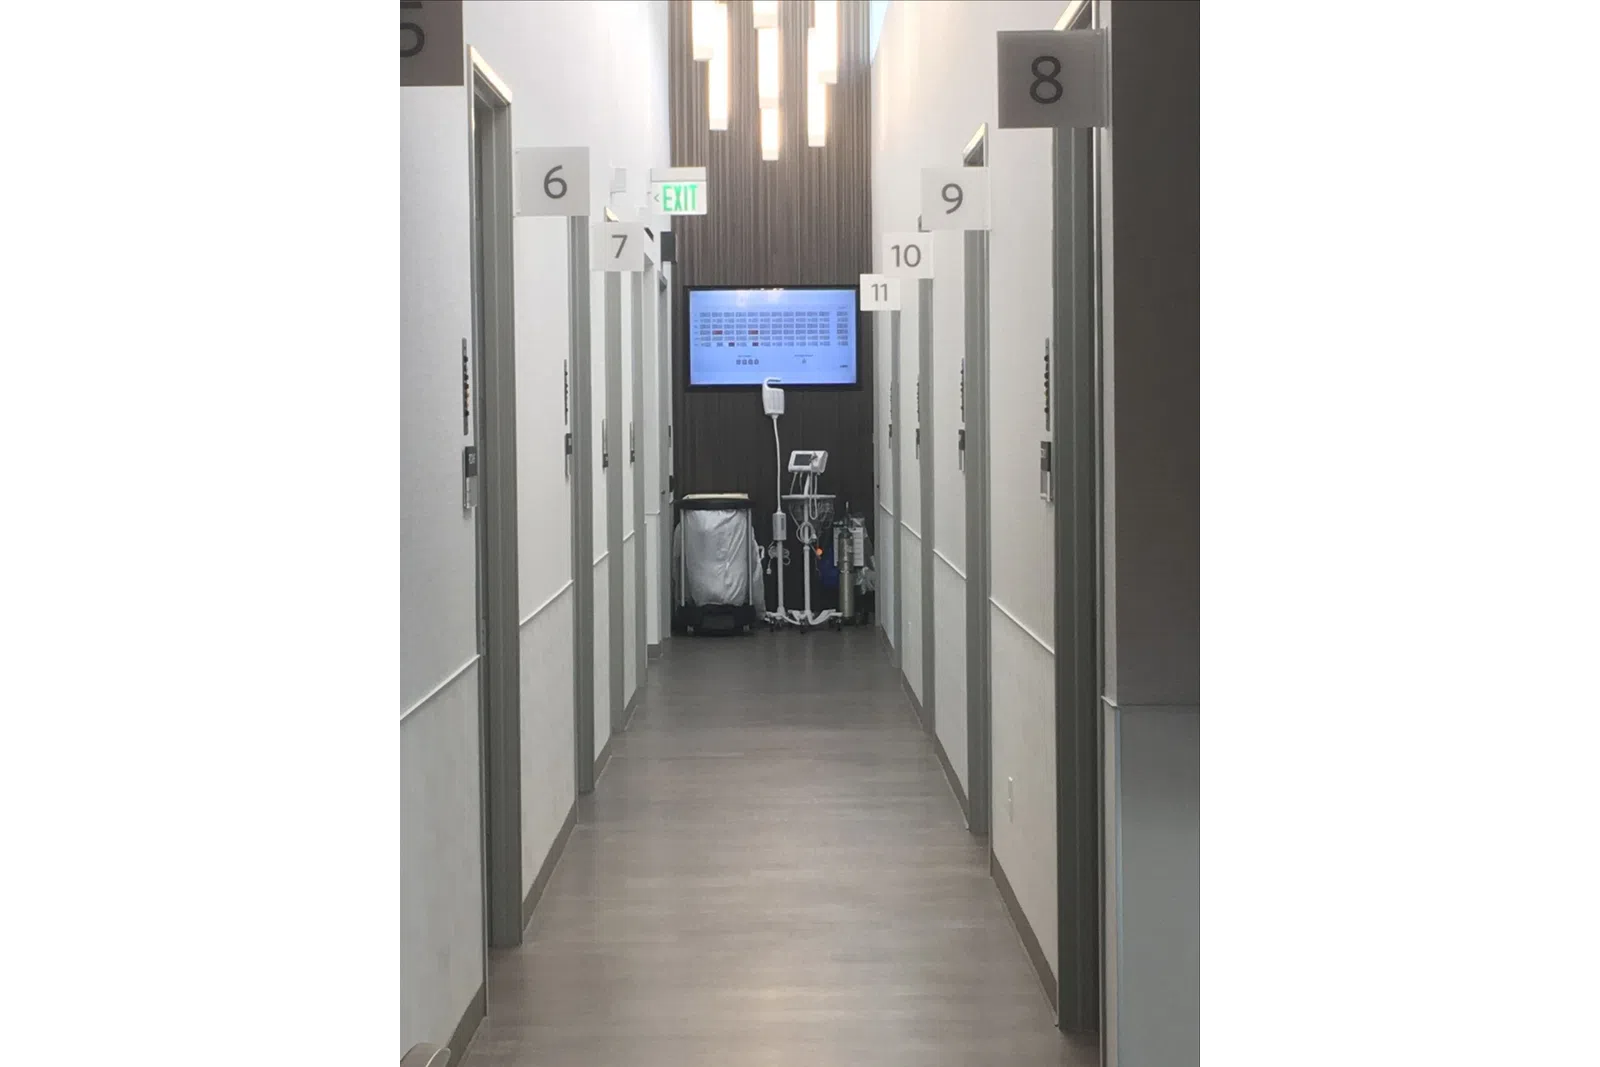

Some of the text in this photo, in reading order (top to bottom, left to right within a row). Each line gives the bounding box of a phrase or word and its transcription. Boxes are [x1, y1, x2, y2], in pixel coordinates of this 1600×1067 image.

[1029, 56, 1064, 104] 8
[543, 165, 567, 199] 6
[662, 184, 698, 211] EXIT
[941, 183, 963, 214] 9
[611, 235, 628, 258] 7
[891, 244, 921, 267] 10
[871, 283, 887, 301] 11
